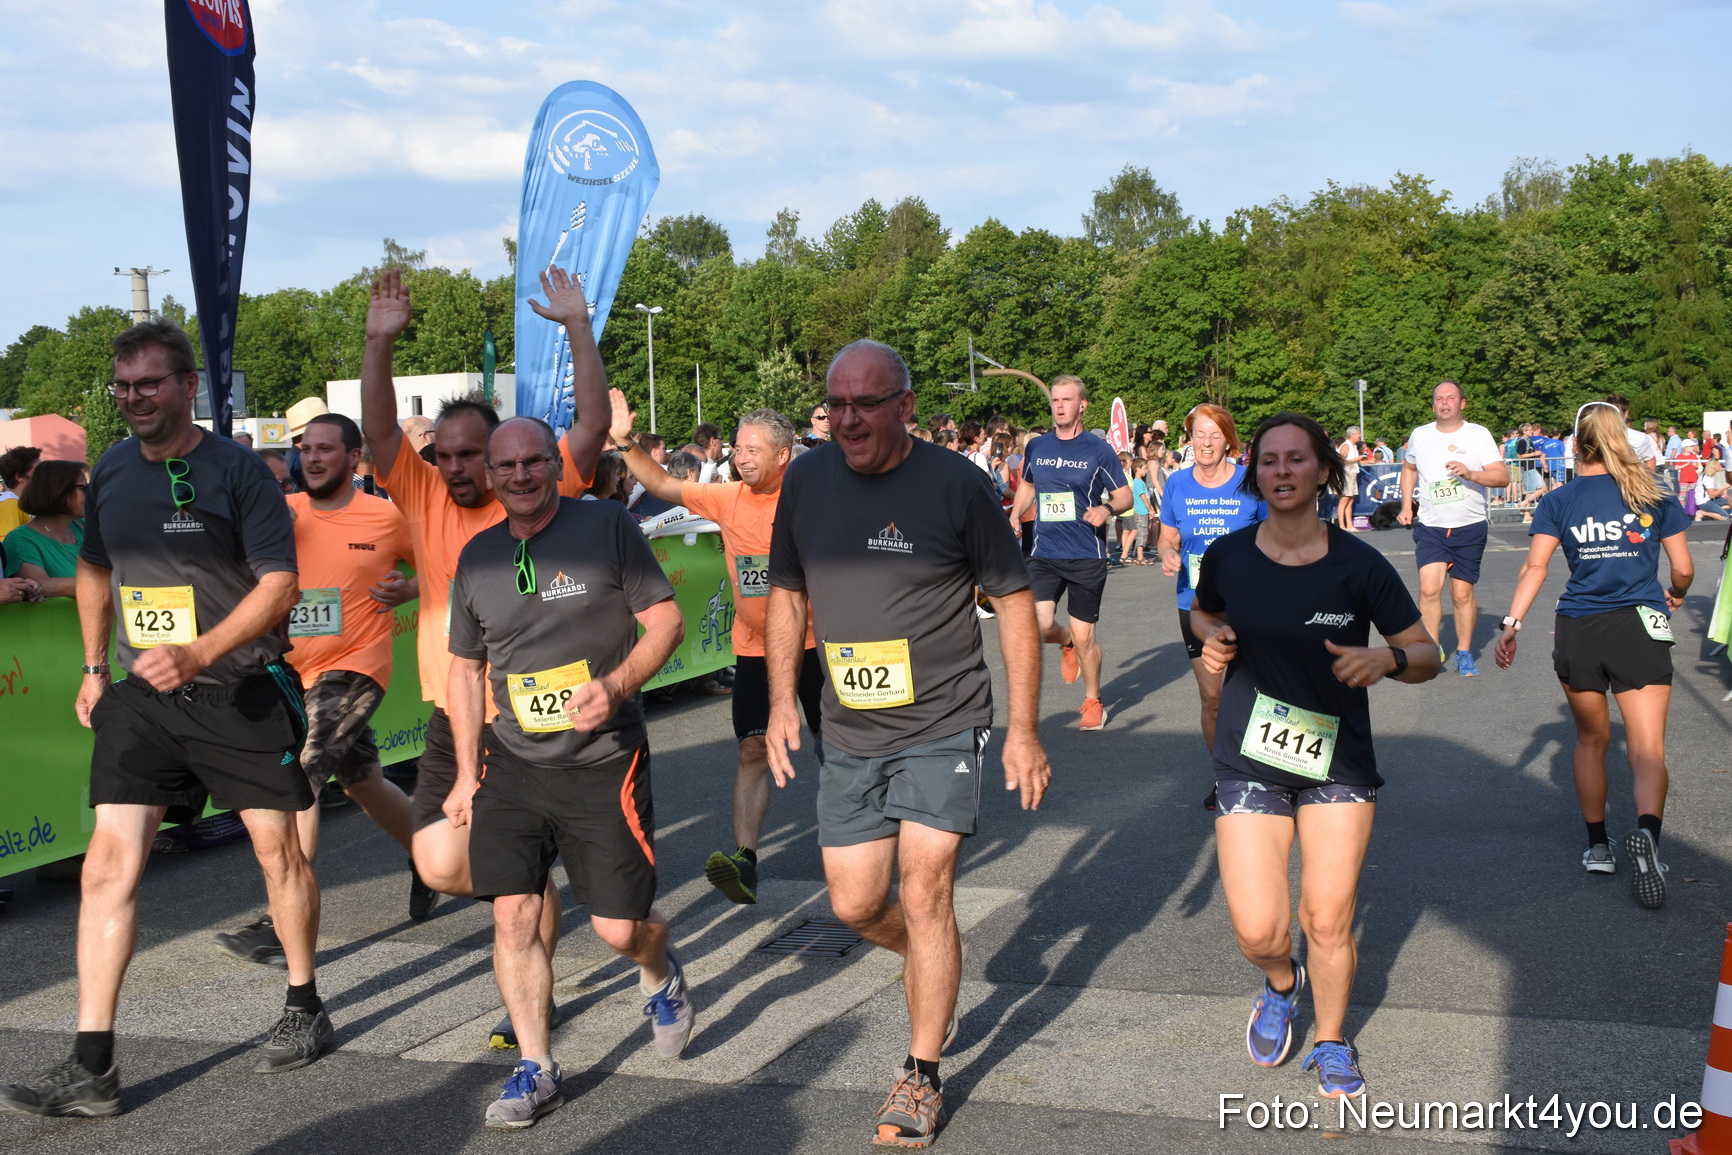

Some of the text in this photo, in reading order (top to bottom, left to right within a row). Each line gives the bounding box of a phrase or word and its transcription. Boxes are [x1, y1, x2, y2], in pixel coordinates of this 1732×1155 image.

[567, 155, 640, 186] WECHSELSZENE
[1433, 486, 1458, 498] 1331
[1185, 498, 1208, 506] Wenn
[1220, 497, 1241, 506] beim
[1045, 503, 1066, 514] 703
[1187, 508, 1239, 516] Hausverkauf
[1198, 517, 1225, 526] richtig
[1193, 527, 1230, 536] LAUFEN
[1570, 516, 1623, 544] vhs
[348, 543, 376, 551] THULE
[867, 538, 913, 549] BURKHARDT
[541, 583, 586, 598] BURKHARDT
[134, 610, 175, 631] 423
[291, 605, 331, 624] 2311
[1305, 612, 1344, 625] JURA
[843, 666, 891, 690] 402
[530, 689, 573, 716] 428
[1260, 721, 1324, 760] 1414
[1284, 751, 1309, 765] Simone
